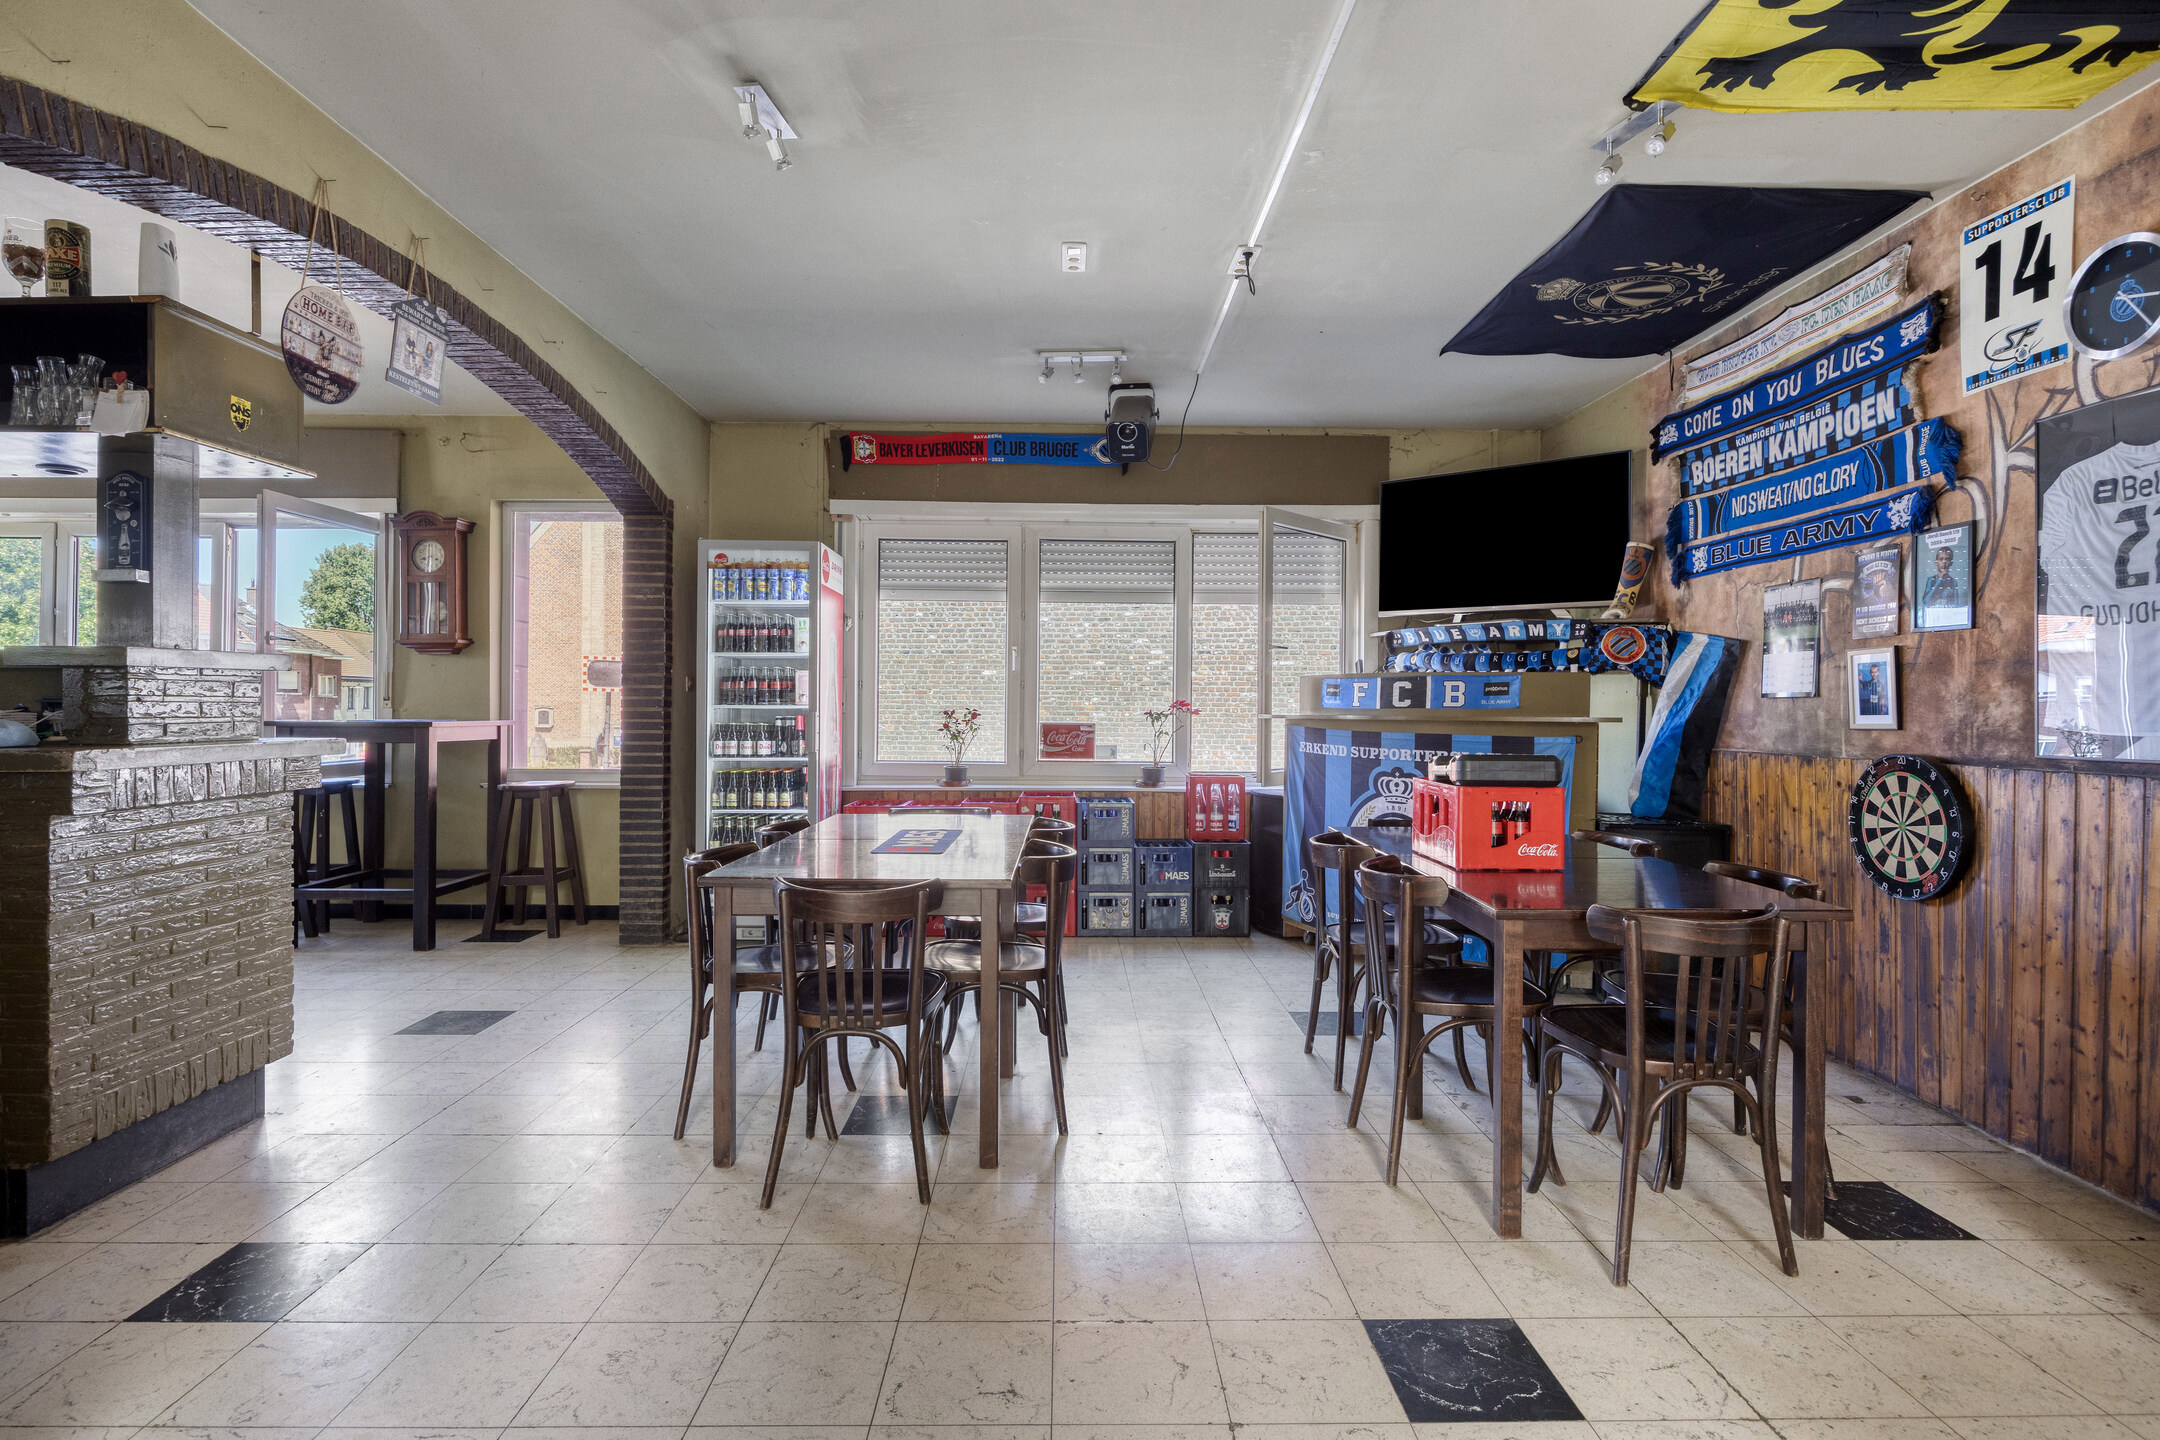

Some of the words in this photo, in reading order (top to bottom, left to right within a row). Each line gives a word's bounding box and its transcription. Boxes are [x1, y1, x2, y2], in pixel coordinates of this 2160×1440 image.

[1967, 187, 2065, 241] SUPPORTERSCLUB
[1975, 220, 2056, 323] 14
[303, 298, 333, 323] HOME
[1821, 295, 1850, 325] DEN
[1684, 405, 1722, 437] COME
[1732, 390, 1754, 419] ON
[1766, 370, 1803, 406] YOU
[1815, 334, 1885, 386] BLUES
[1968, 361, 2041, 390] SUPPORTERSFEDERATIE
[230, 402, 251, 418] ONS
[1691, 442, 1764, 488] BOEREN
[1767, 386, 1897, 465] KAMPIOEN
[1735, 426, 1778, 447] KAMPIOEN
[1778, 418, 1797, 430] VAN
[1799, 402, 1831, 424] BELGIË
[879, 442, 914, 458] BAYER
[915, 441, 984, 458] LEVERKUSEN
[993, 440, 1026, 456] CLUB
[1030, 441, 1079, 458] BRUGGE
[1710, 535, 1772, 565] BLUE
[1781, 508, 1882, 550] ARMY
[2115, 504, 2160, 590] 2
[1406, 626, 1464, 644] BLUE
[1489, 622, 1565, 638] ARMY
[1046, 730, 1088, 746] Coca-Cola
[1299, 741, 1347, 757] ERKEND
[1897, 756, 1906, 765] 20
[1517, 843, 1559, 857] Coca-Cola
[1165, 871, 1189, 880] MAES
